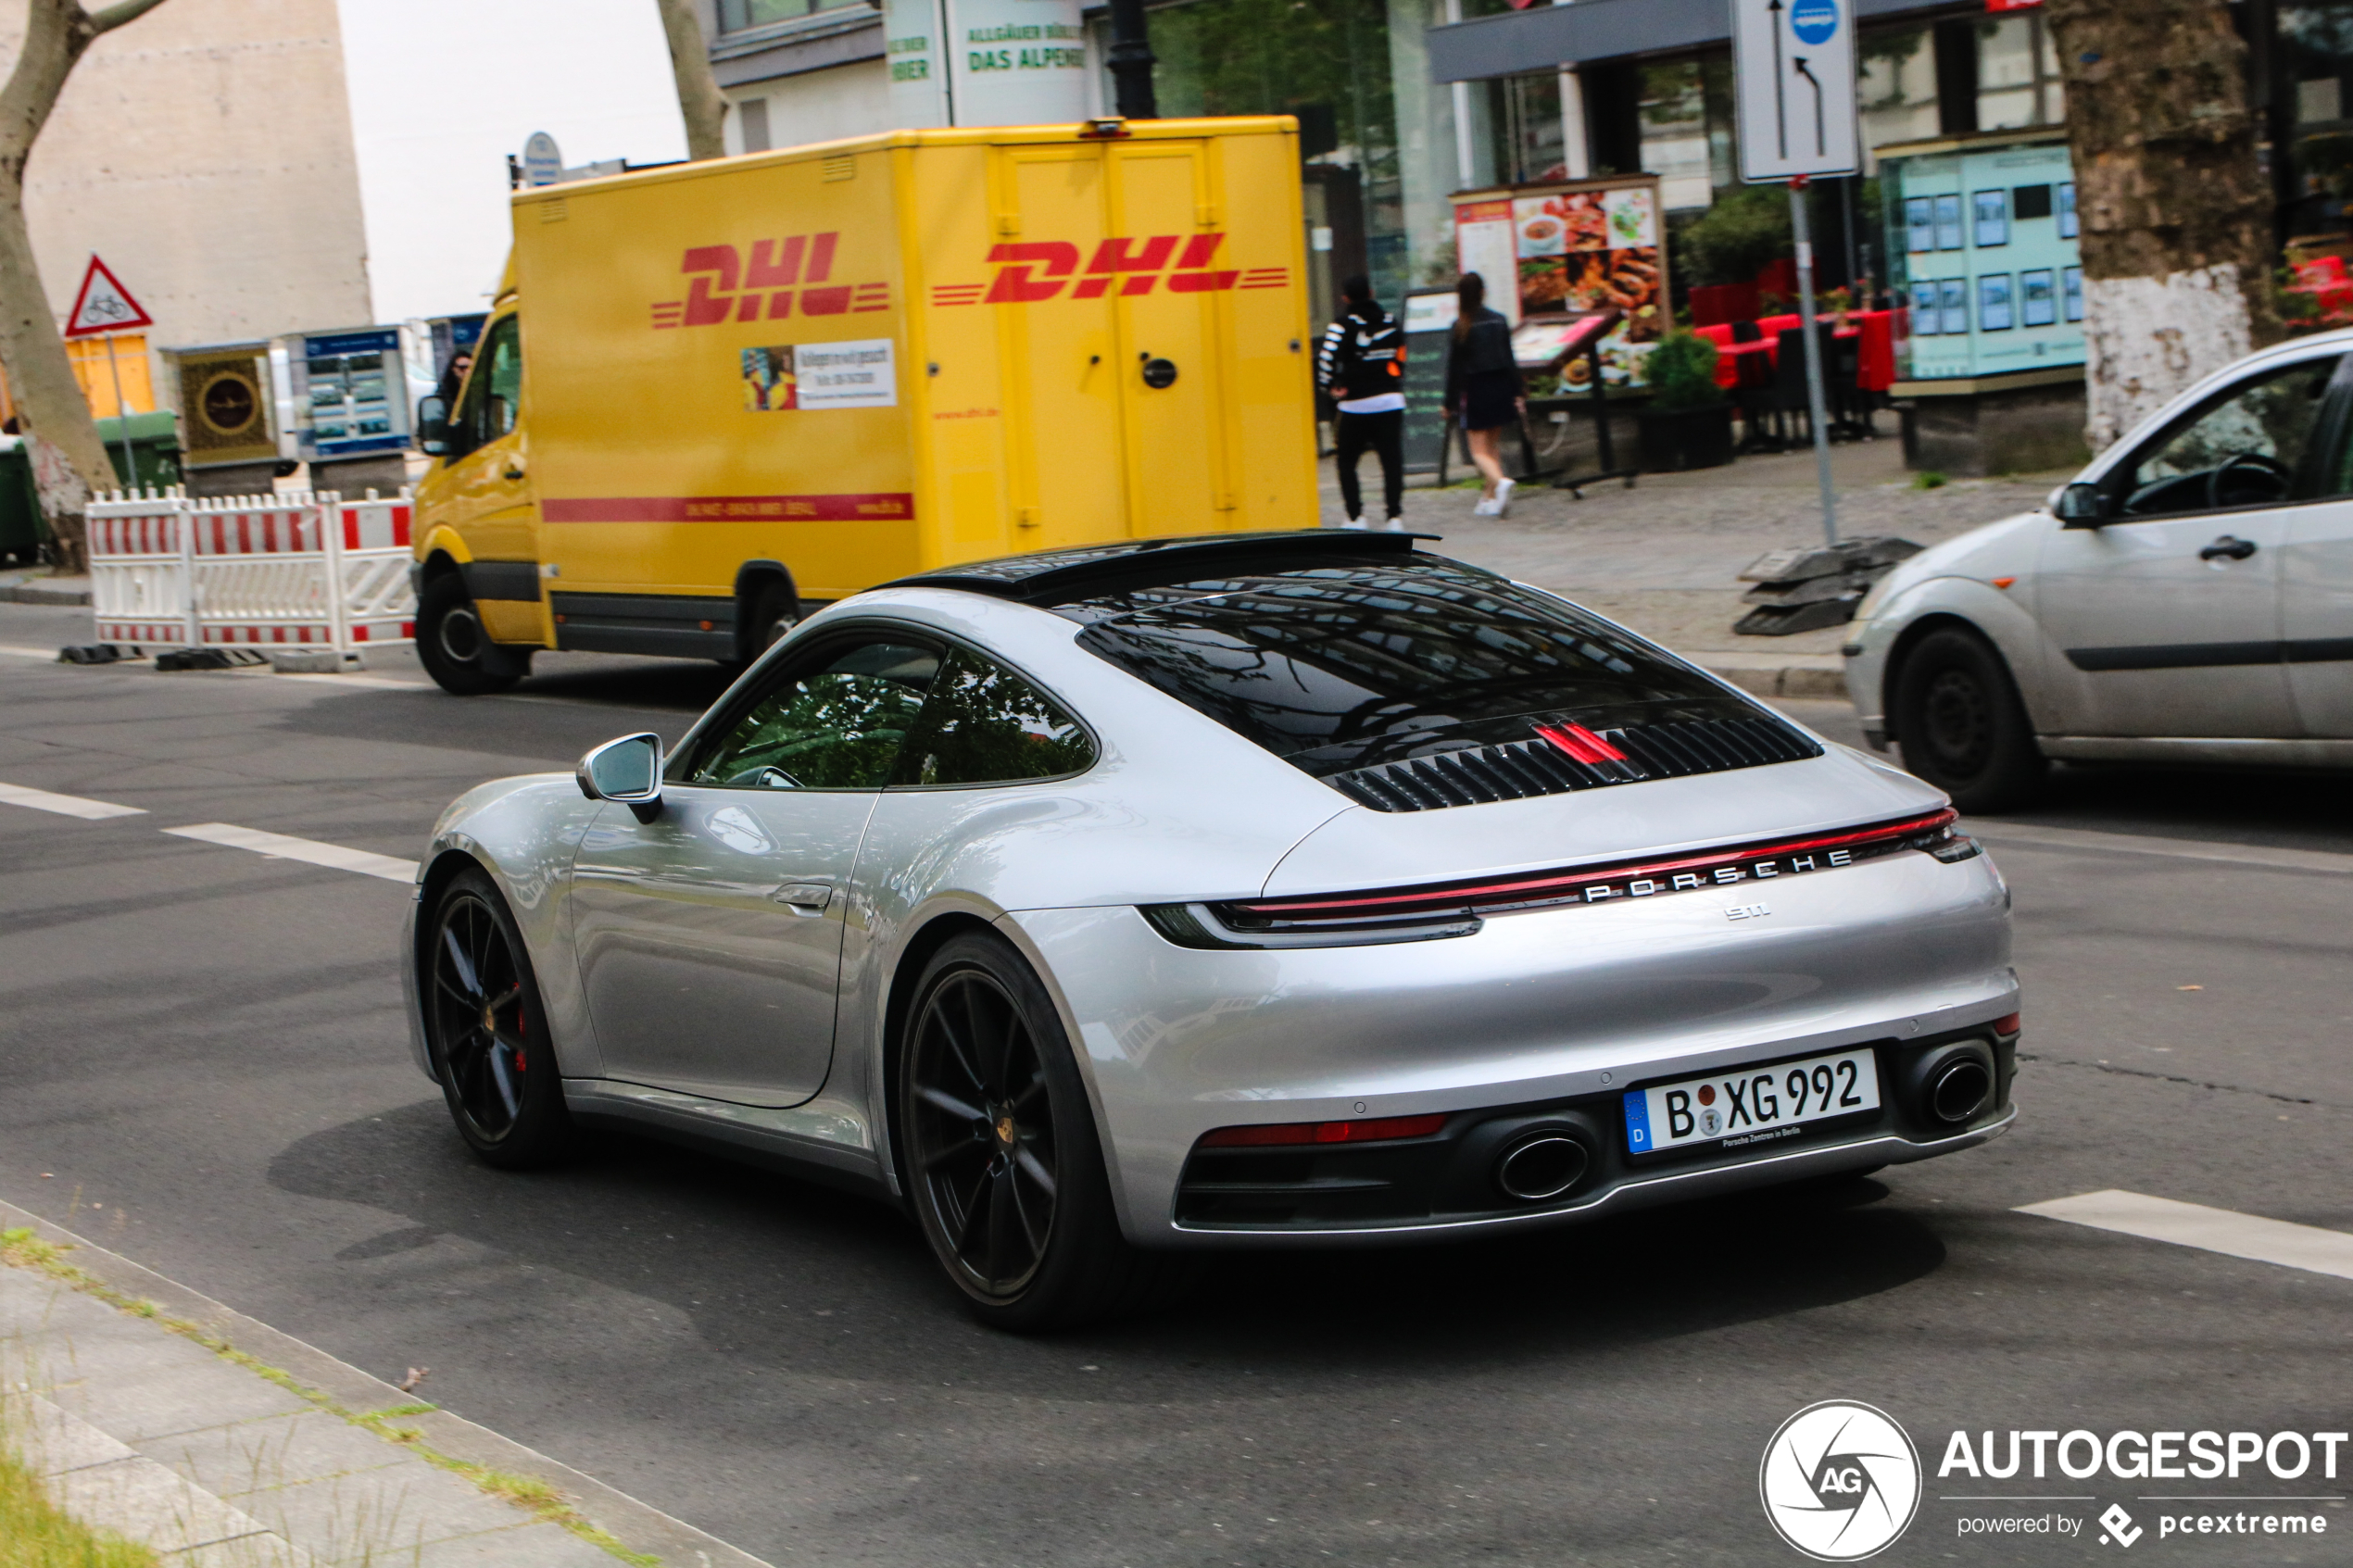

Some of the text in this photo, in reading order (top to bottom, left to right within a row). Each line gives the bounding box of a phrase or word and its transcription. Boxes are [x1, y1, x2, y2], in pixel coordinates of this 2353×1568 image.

[967, 23, 1040, 43] ALLGÄUER
[968, 49, 1012, 71] DAS
[984, 232, 1241, 304] DHL
[681, 232, 852, 327] DHL
[1584, 849, 1852, 903] PORSCHE
[1724, 902, 1771, 921] 911
[1666, 1060, 1862, 1139] B XG 992
[1633, 1128, 1644, 1143] D
[1723, 1136, 1749, 1148] Porsche
[1775, 1130, 1781, 1138] in
[1782, 1127, 1800, 1136] Berlin
